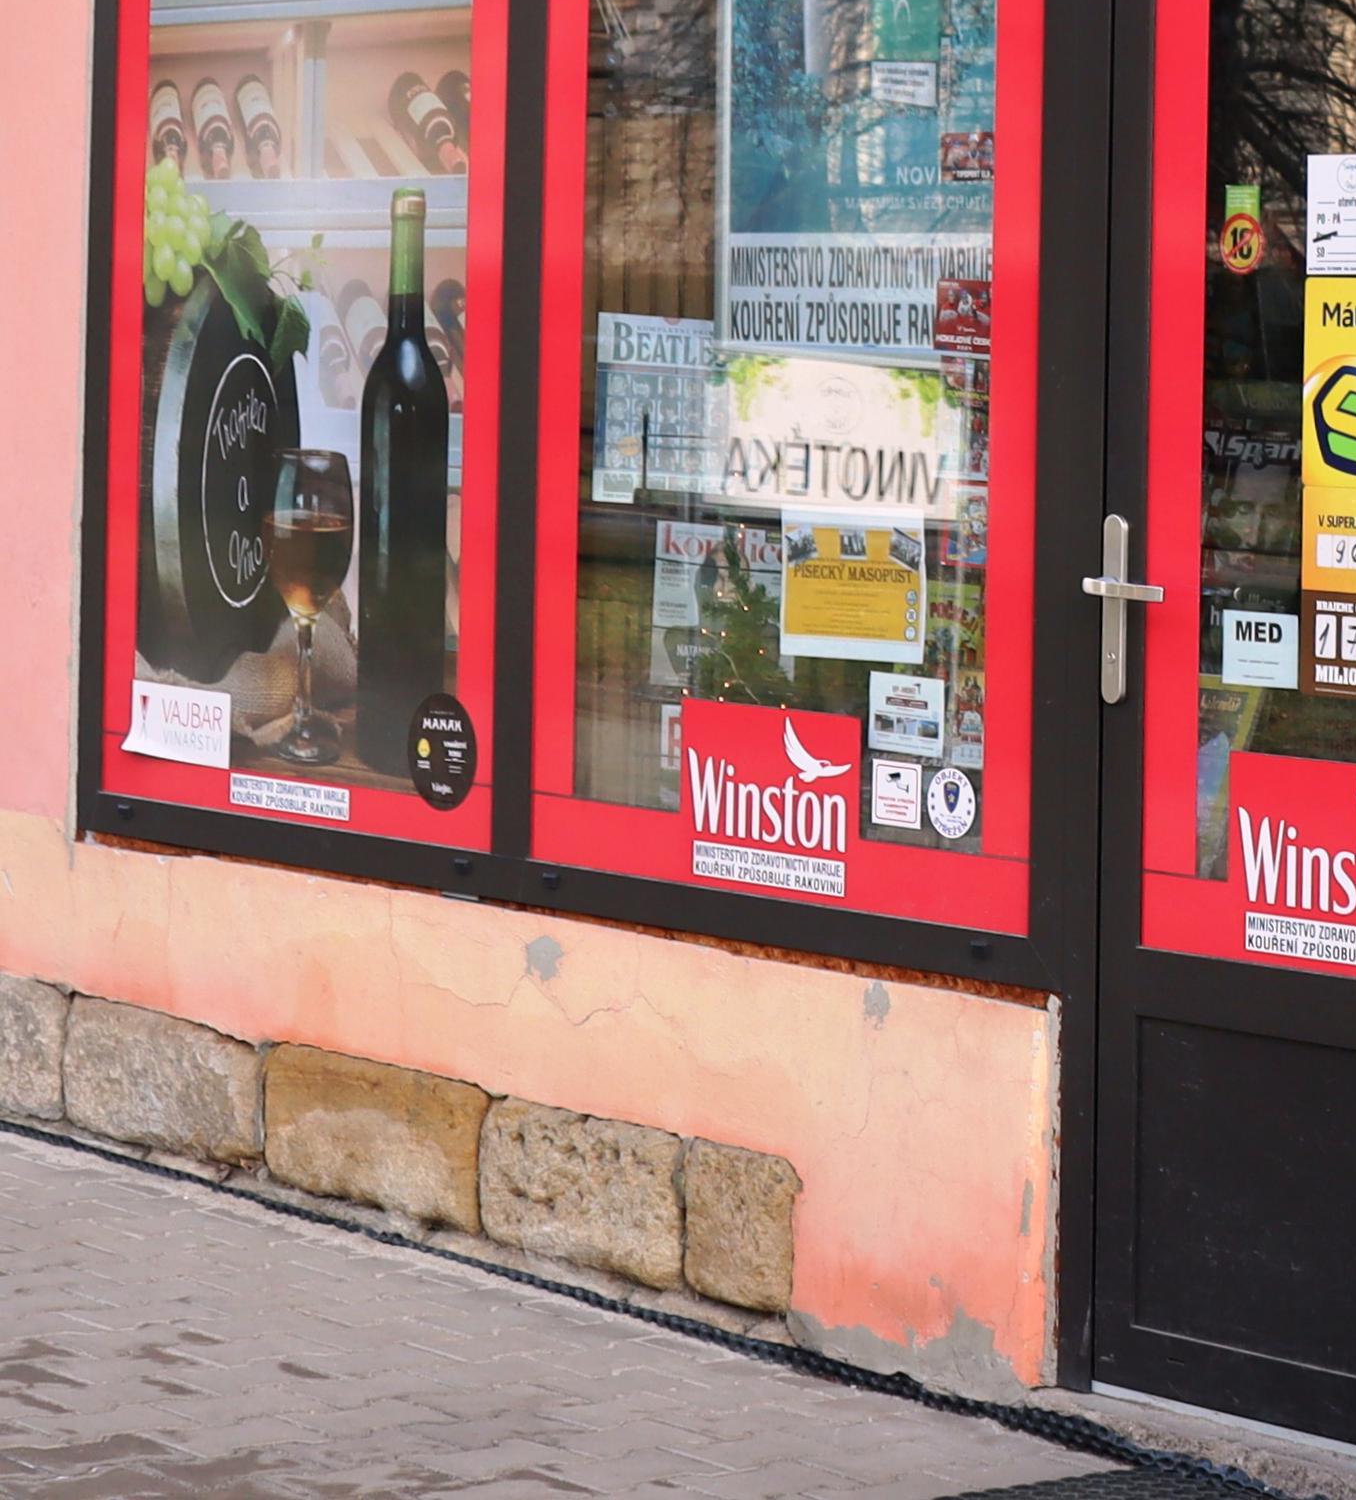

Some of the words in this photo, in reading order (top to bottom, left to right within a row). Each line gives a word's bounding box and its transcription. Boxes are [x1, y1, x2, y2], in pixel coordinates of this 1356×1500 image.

[731, 247, 824, 288] MINISTERSTVO
[829, 239, 935, 290] ZDRAVOTNICTVÍ
[731, 293, 800, 342] KOUŘENÍ
[806, 293, 902, 344] ZPŮSOBUJE
[238, 475, 250, 512] a
[1318, 515, 1326, 527] V
[848, 565, 913, 584] MASOPUST
[1235, 620, 1283, 644] MED
[161, 698, 223, 733] VAJBAR
[934, 768, 969, 790] OBJEKT
[688, 747, 846, 853] Winston
[695, 843, 749, 863] MINISTERSTVO
[751, 851, 810, 871] ZDRAVOTNICTVÍ
[695, 859, 735, 875] KOUŘENÍ
[738, 866, 791, 886] ZPŮSOBUJE
[794, 876, 843, 895] RAKOVINU
[1247, 915, 1316, 938] MINISTERSTVO
[1247, 932, 1299, 955] KOUŘENÍ
